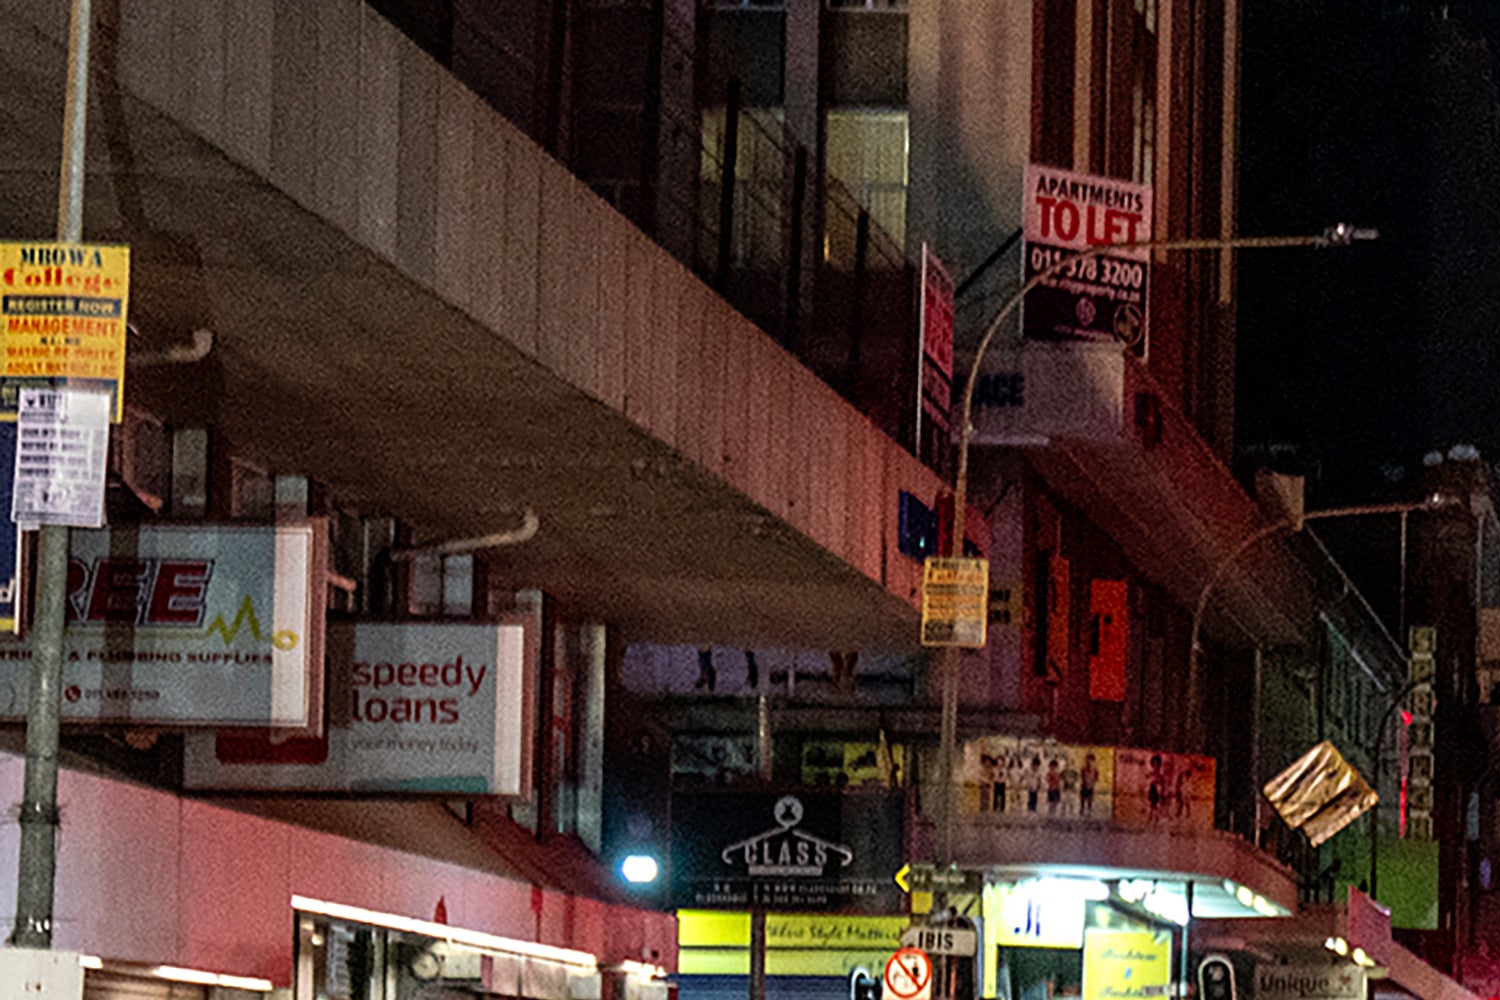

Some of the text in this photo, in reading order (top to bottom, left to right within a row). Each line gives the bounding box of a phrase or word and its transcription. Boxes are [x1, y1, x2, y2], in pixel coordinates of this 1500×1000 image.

[1036, 175, 1143, 212] APARTMENTS
[1036, 195, 1143, 249] TO LET
[21, 248, 103, 268] MBOWA
[3, 266, 120, 294] College
[1066, 257, 1098, 281] 378
[1100, 259, 1143, 289] 3200
[8, 317, 117, 337] MANAGEMENT
[86, 650, 182, 664] PLUMBING
[186, 651, 273, 666] SUPPLIES
[352, 655, 487, 697] speedy
[351, 689, 460, 724] loans
[744, 840, 827, 866] CLASS
[918, 931, 954, 950] IBIS
[1260, 972, 1330, 997] Unique
